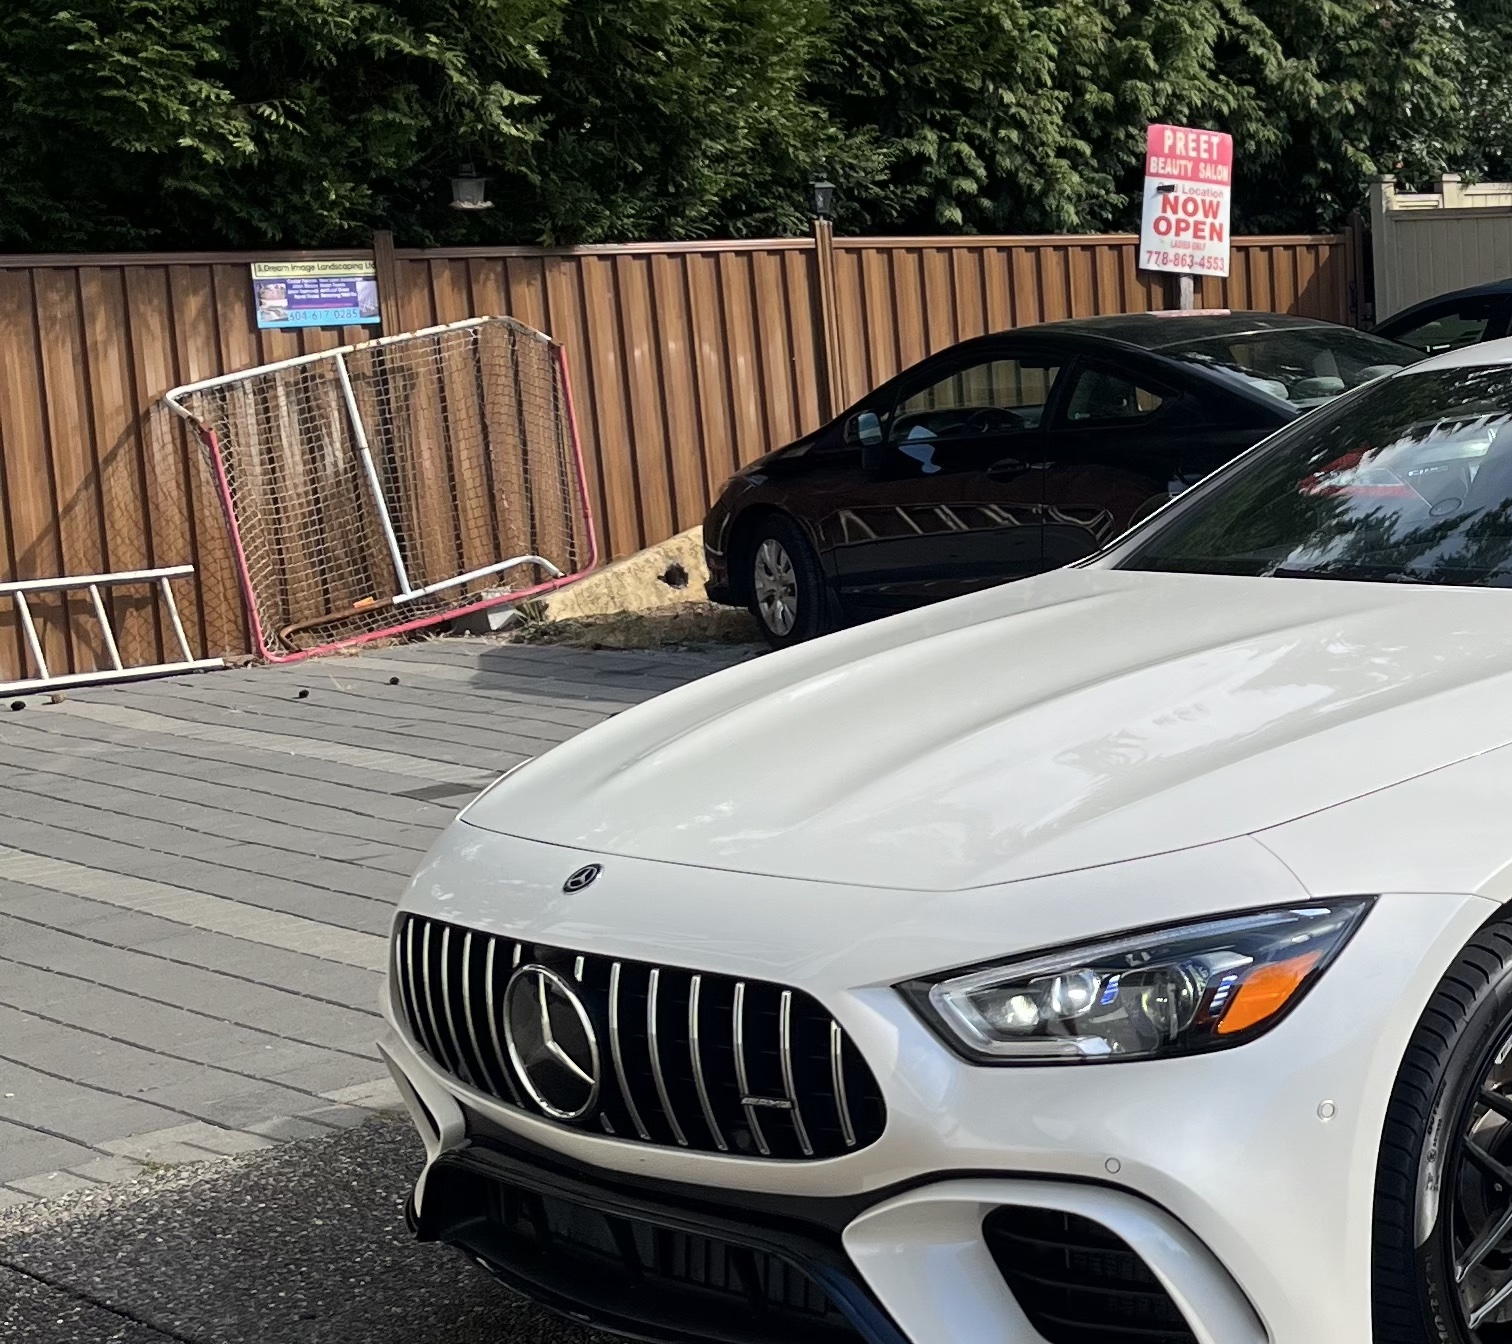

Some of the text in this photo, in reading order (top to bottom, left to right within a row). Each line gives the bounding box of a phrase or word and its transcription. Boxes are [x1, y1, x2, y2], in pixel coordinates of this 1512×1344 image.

[1163, 129, 1220, 160] PREET
[1150, 156, 1229, 182] BEAUTY SALON
[1182, 183, 1224, 199] Location
[1161, 193, 1220, 220] NOW
[1153, 216, 1224, 243] OPEN
[291, 264, 315, 273] Image
[317, 262, 363, 271] Landscaping
[1146, 250, 1225, 271] 778-863-4553
[312, 310, 329, 320] 617
[334, 308, 358, 319] 0285
